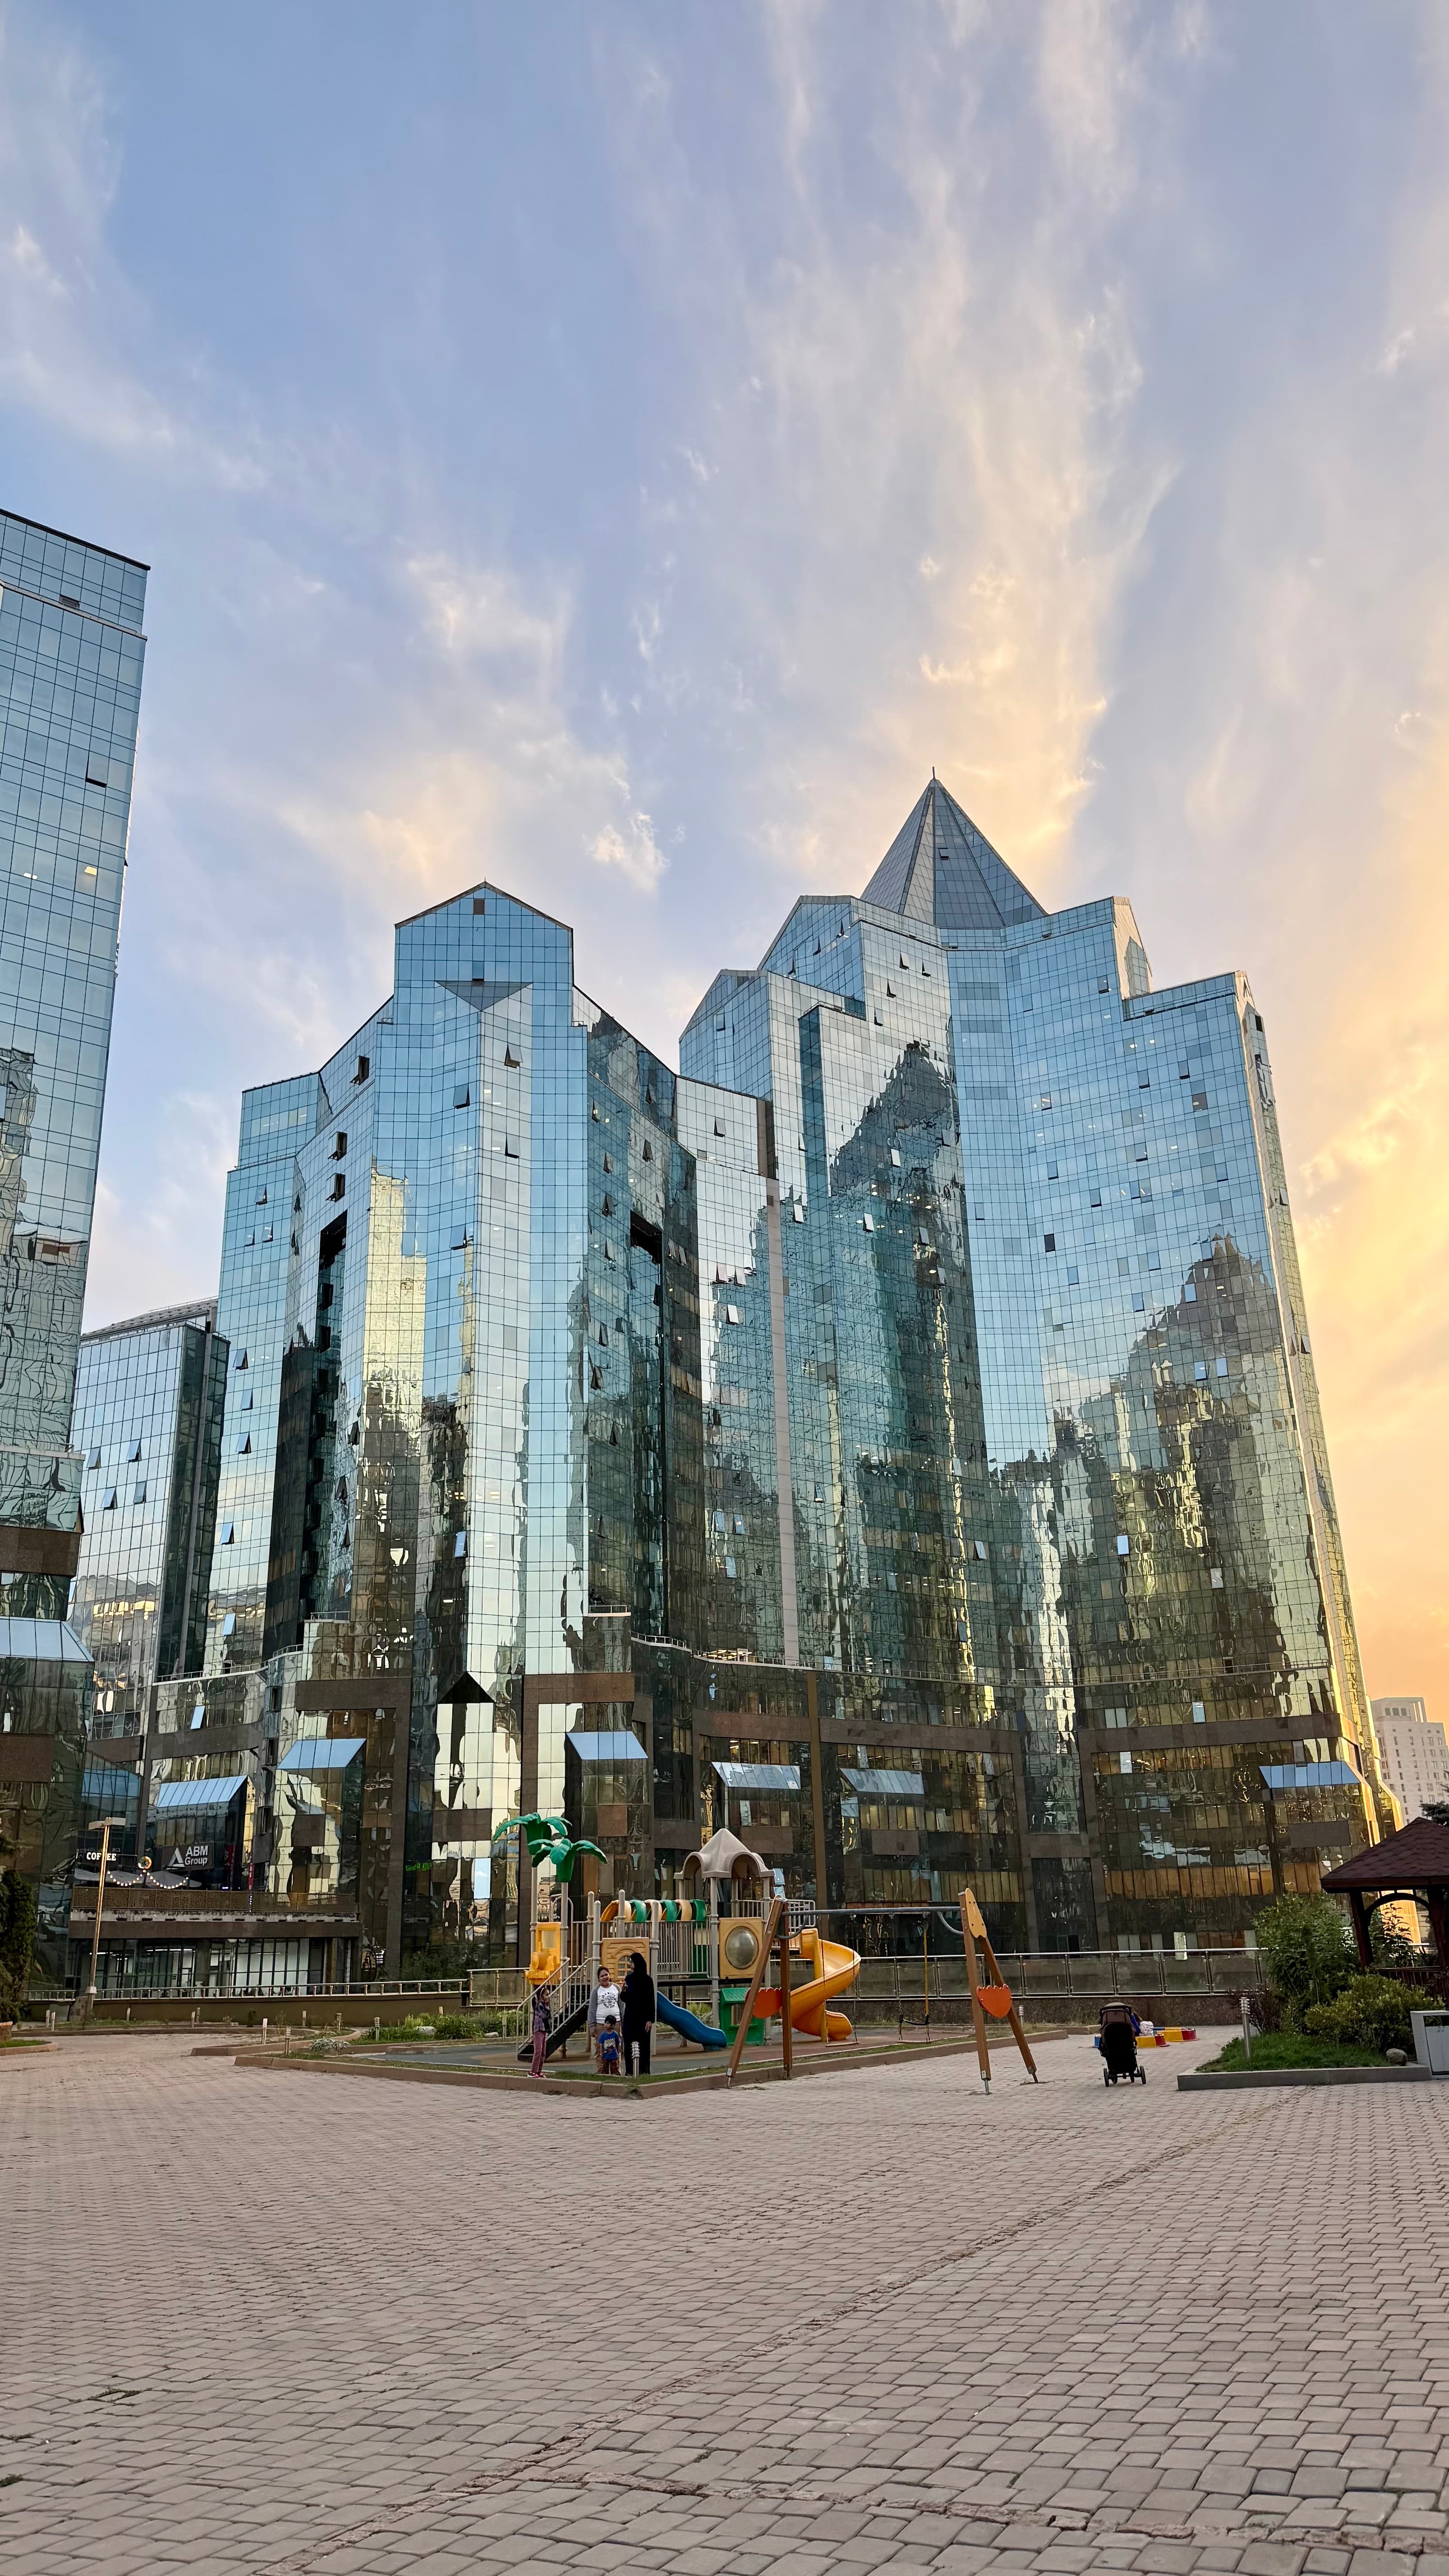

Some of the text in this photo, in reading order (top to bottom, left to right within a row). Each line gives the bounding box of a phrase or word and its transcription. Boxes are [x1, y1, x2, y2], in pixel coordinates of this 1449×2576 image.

[185, 1845, 208, 1857] ABM
[87, 1852, 116, 1861] COFEE
[184, 1857, 208, 1866] Group
